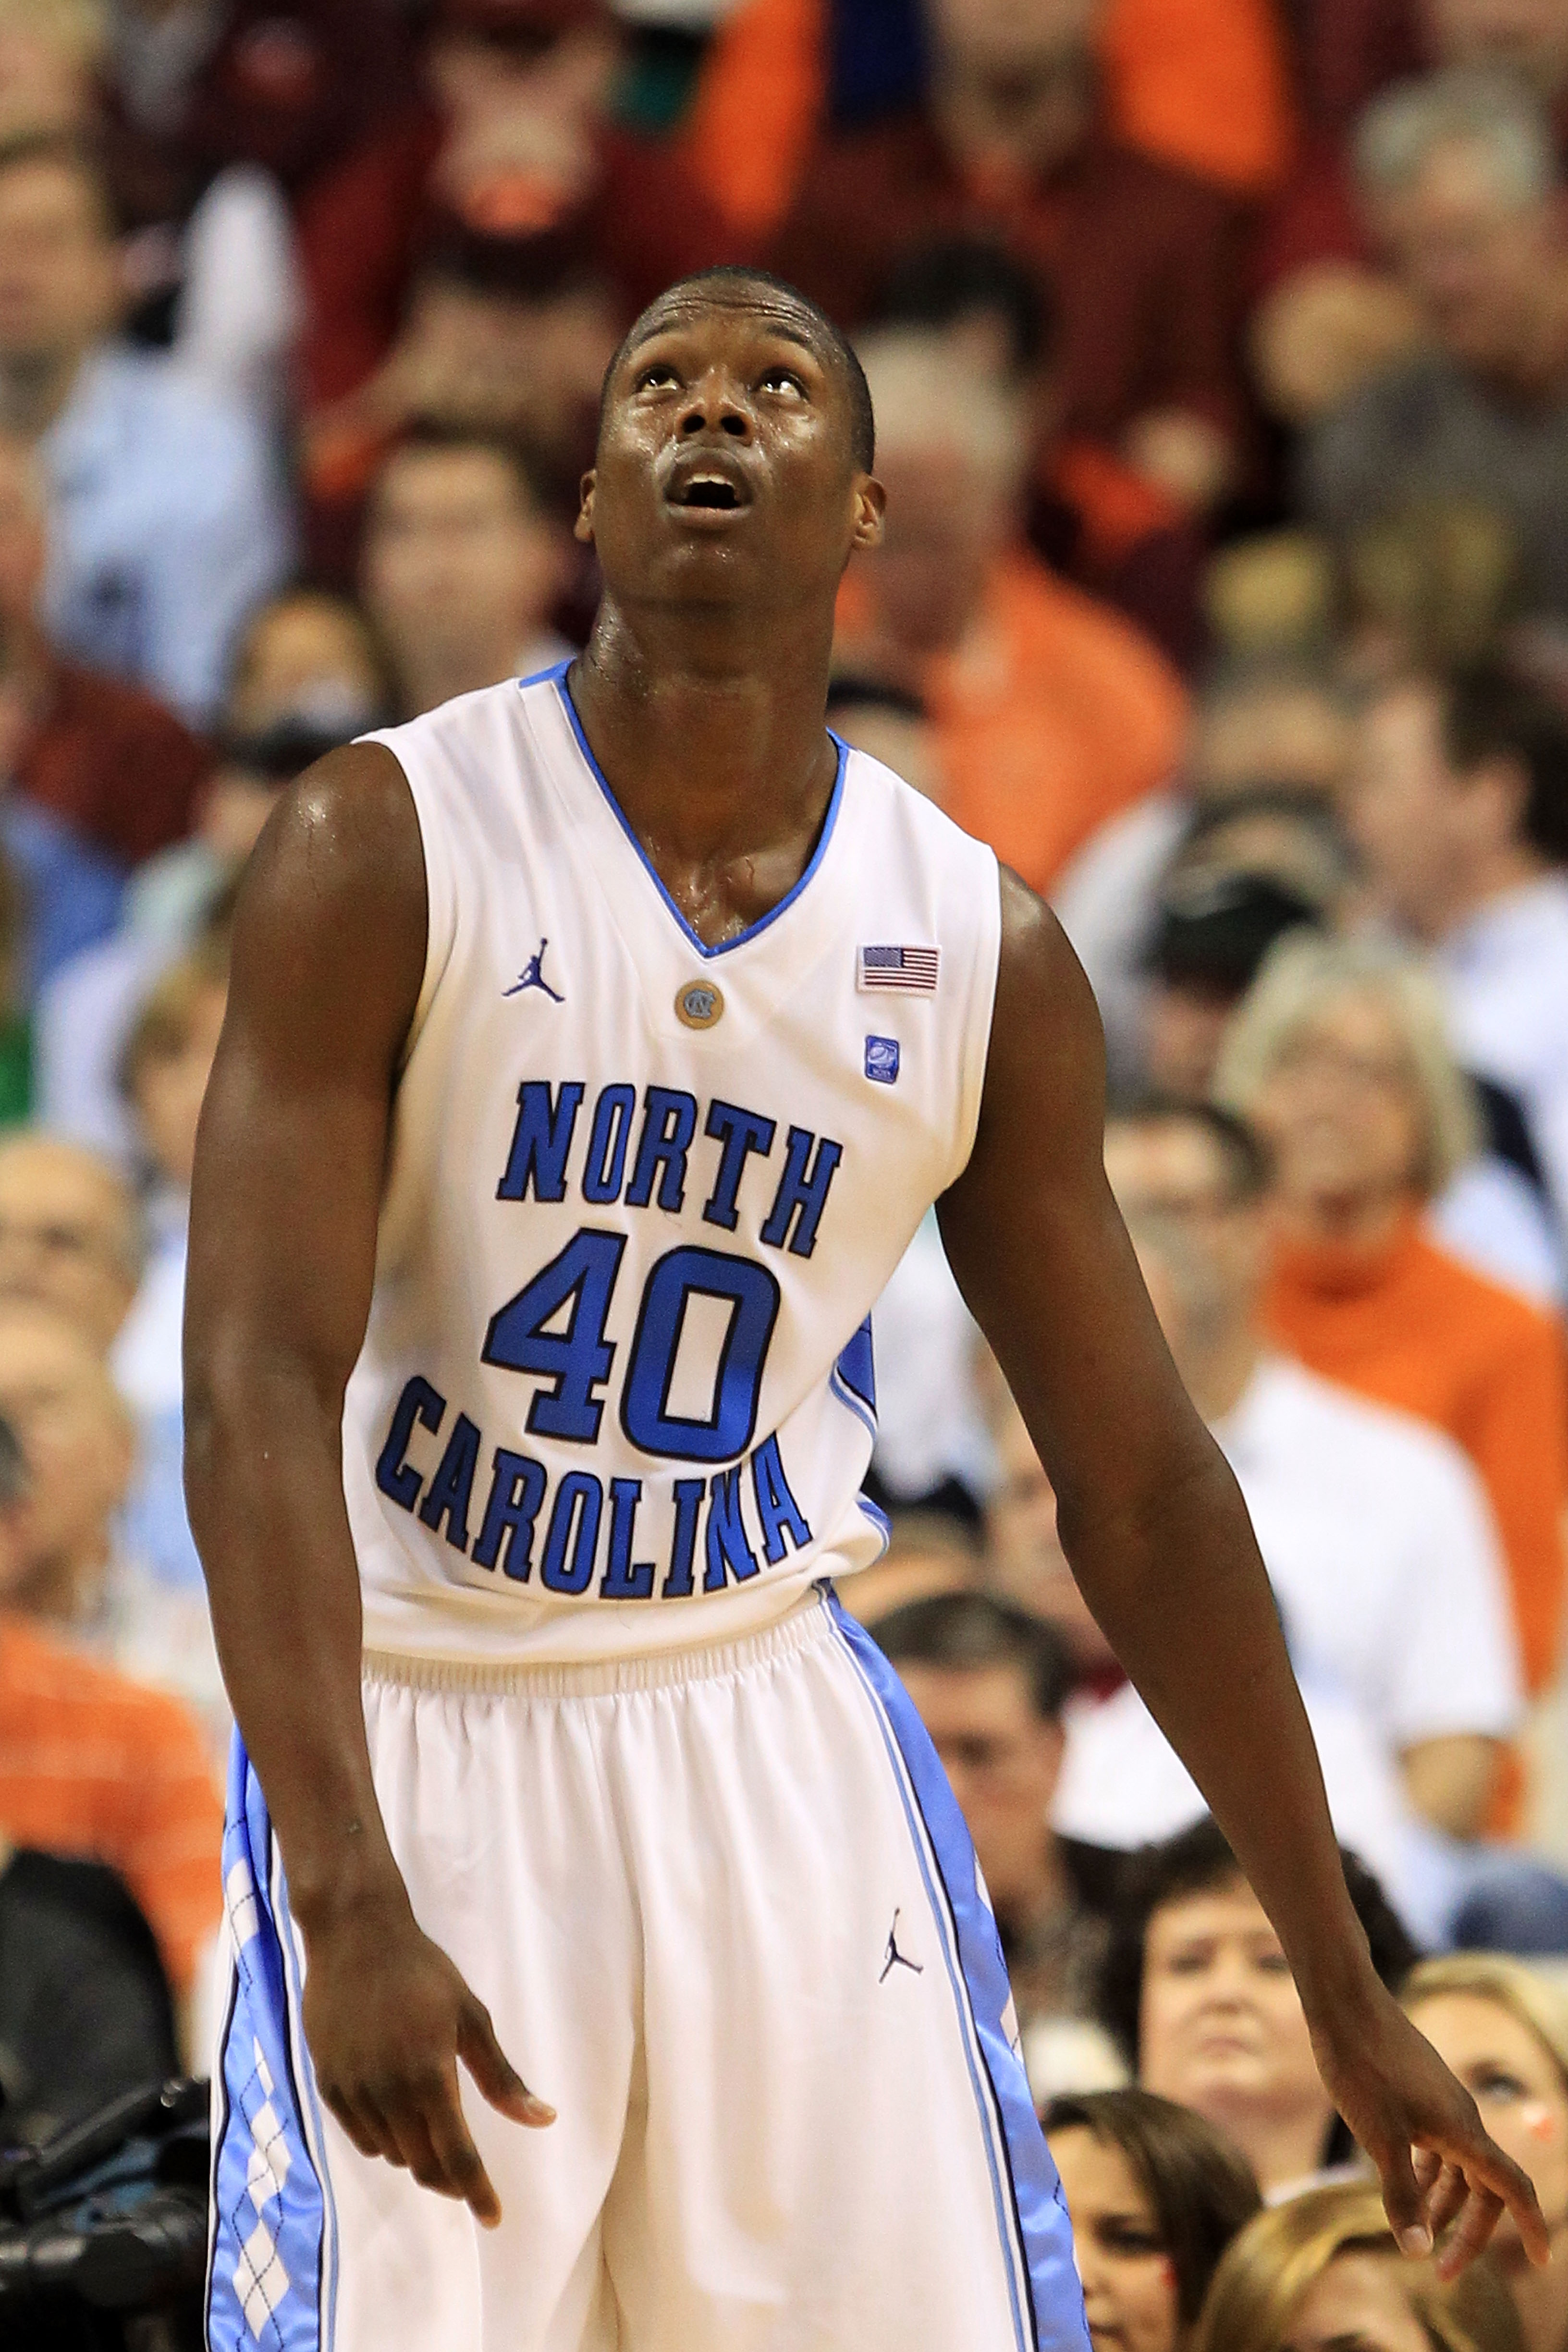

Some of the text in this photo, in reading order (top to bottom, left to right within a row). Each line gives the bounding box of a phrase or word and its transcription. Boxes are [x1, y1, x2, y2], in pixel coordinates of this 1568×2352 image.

[496, 1081, 843, 1259] NORTH
[481, 1227, 780, 1463] 40
[375, 1376, 813, 1600] CAROLINA
